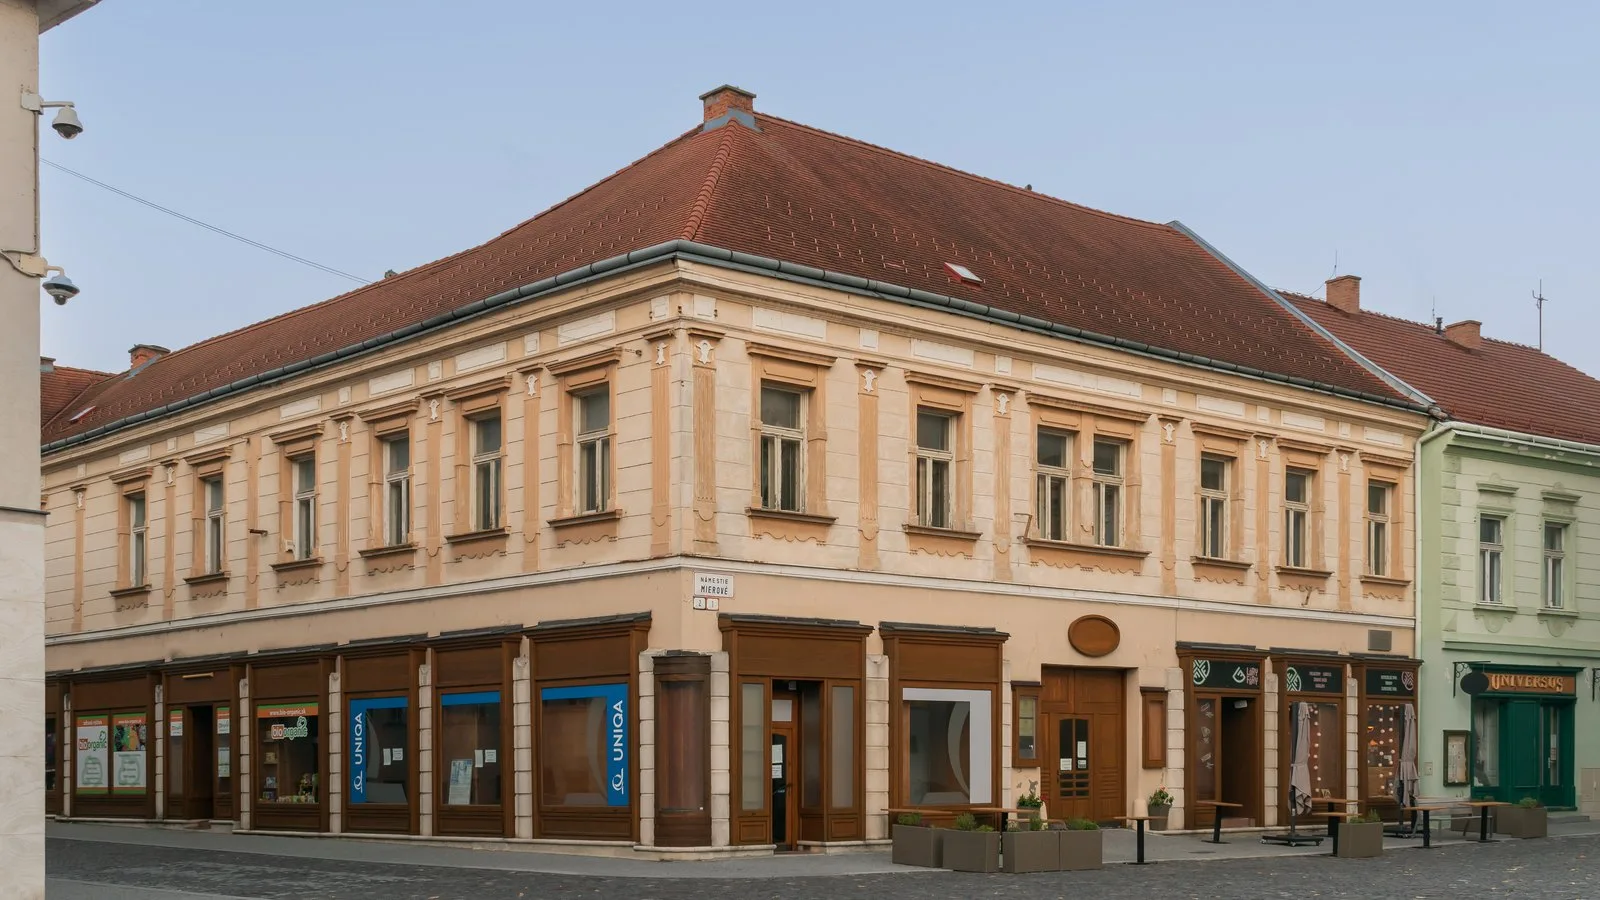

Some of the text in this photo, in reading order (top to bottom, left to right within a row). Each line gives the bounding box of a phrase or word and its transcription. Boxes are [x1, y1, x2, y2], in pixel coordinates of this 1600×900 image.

[701, 576, 728, 585] NÁMESTIE
[701, 585, 728, 595] MIEROVÉ
[1491, 674, 1564, 692] UNIVERSUS
[354, 712, 363, 765] UNIQA
[613, 700, 624, 761] UNIQA
